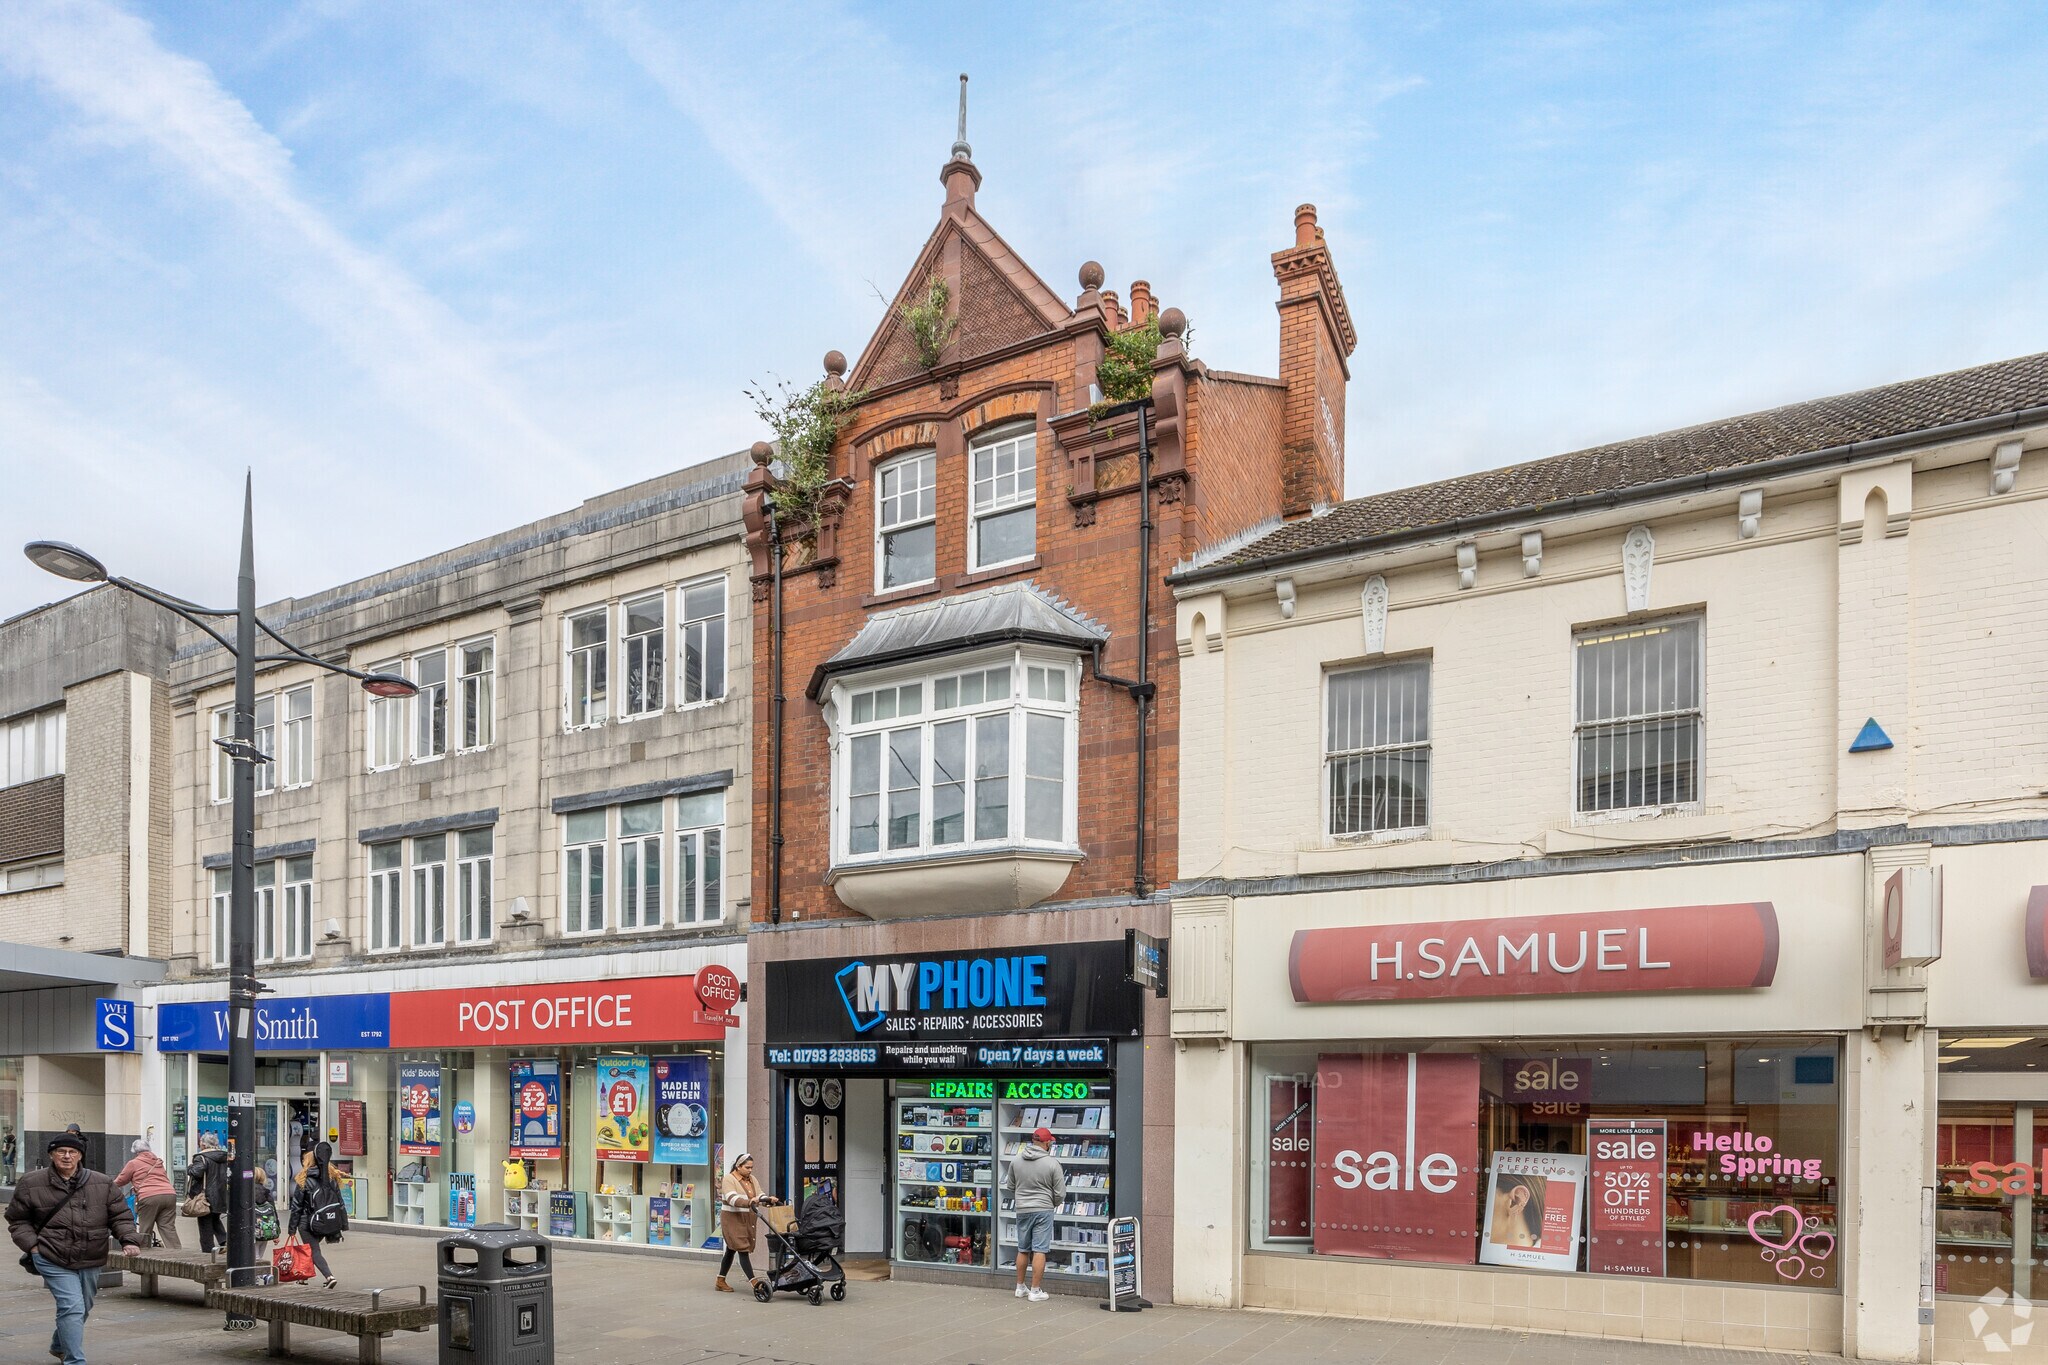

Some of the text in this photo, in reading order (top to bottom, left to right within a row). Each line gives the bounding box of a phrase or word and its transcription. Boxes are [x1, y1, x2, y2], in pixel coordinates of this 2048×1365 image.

[1369, 927, 1671, 981] H.SAMUEL
[708, 973, 732, 987] POST
[702, 986, 736, 1000] OFFICE
[103, 1002, 127, 1014] WH
[460, 994, 632, 1032] POST OFFICE
[718, 1016, 734, 1024] Mney
[886, 1013, 1043, 1032] SALES REPAIRS ACCESSORIES
[104, 1013, 130, 1047] S
[770, 1048, 876, 1062] Tel: 01793 293863
[886, 1046, 913, 1056] Repairs
[930, 1046, 967, 1055] unlocking
[979, 1046, 1103, 1064] Open 7 days a week
[632, 1059, 646, 1067] Play
[903, 1055, 955, 1065] while you wait
[418, 1069, 439, 1077] Books
[1515, 1058, 1579, 1090] sale
[662, 1082, 700, 1090] MADE IN
[1006, 1082, 1088, 1098] ACCESSO
[411, 1091, 418, 1104] 3
[422, 1091, 429, 1104] 2
[523, 1092, 531, 1106] 3
[536, 1092, 545, 1106] 2
[613, 1093, 632, 1112] £1
[662, 1091, 700, 1100] SWEDEN
[198, 1102, 228, 1114] apes
[1597, 1135, 1656, 1160] sale
[1693, 1132, 1773, 1152] Hello
[1500, 1156, 1557, 1164] PERFECT
[1720, 1153, 1822, 1180] Spring
[450, 1174, 475, 1190] PRIME
[1604, 1172, 1650, 1188] 50%
[1604, 1189, 1650, 1206] OFF
[1544, 1214, 1567, 1223] FREE
